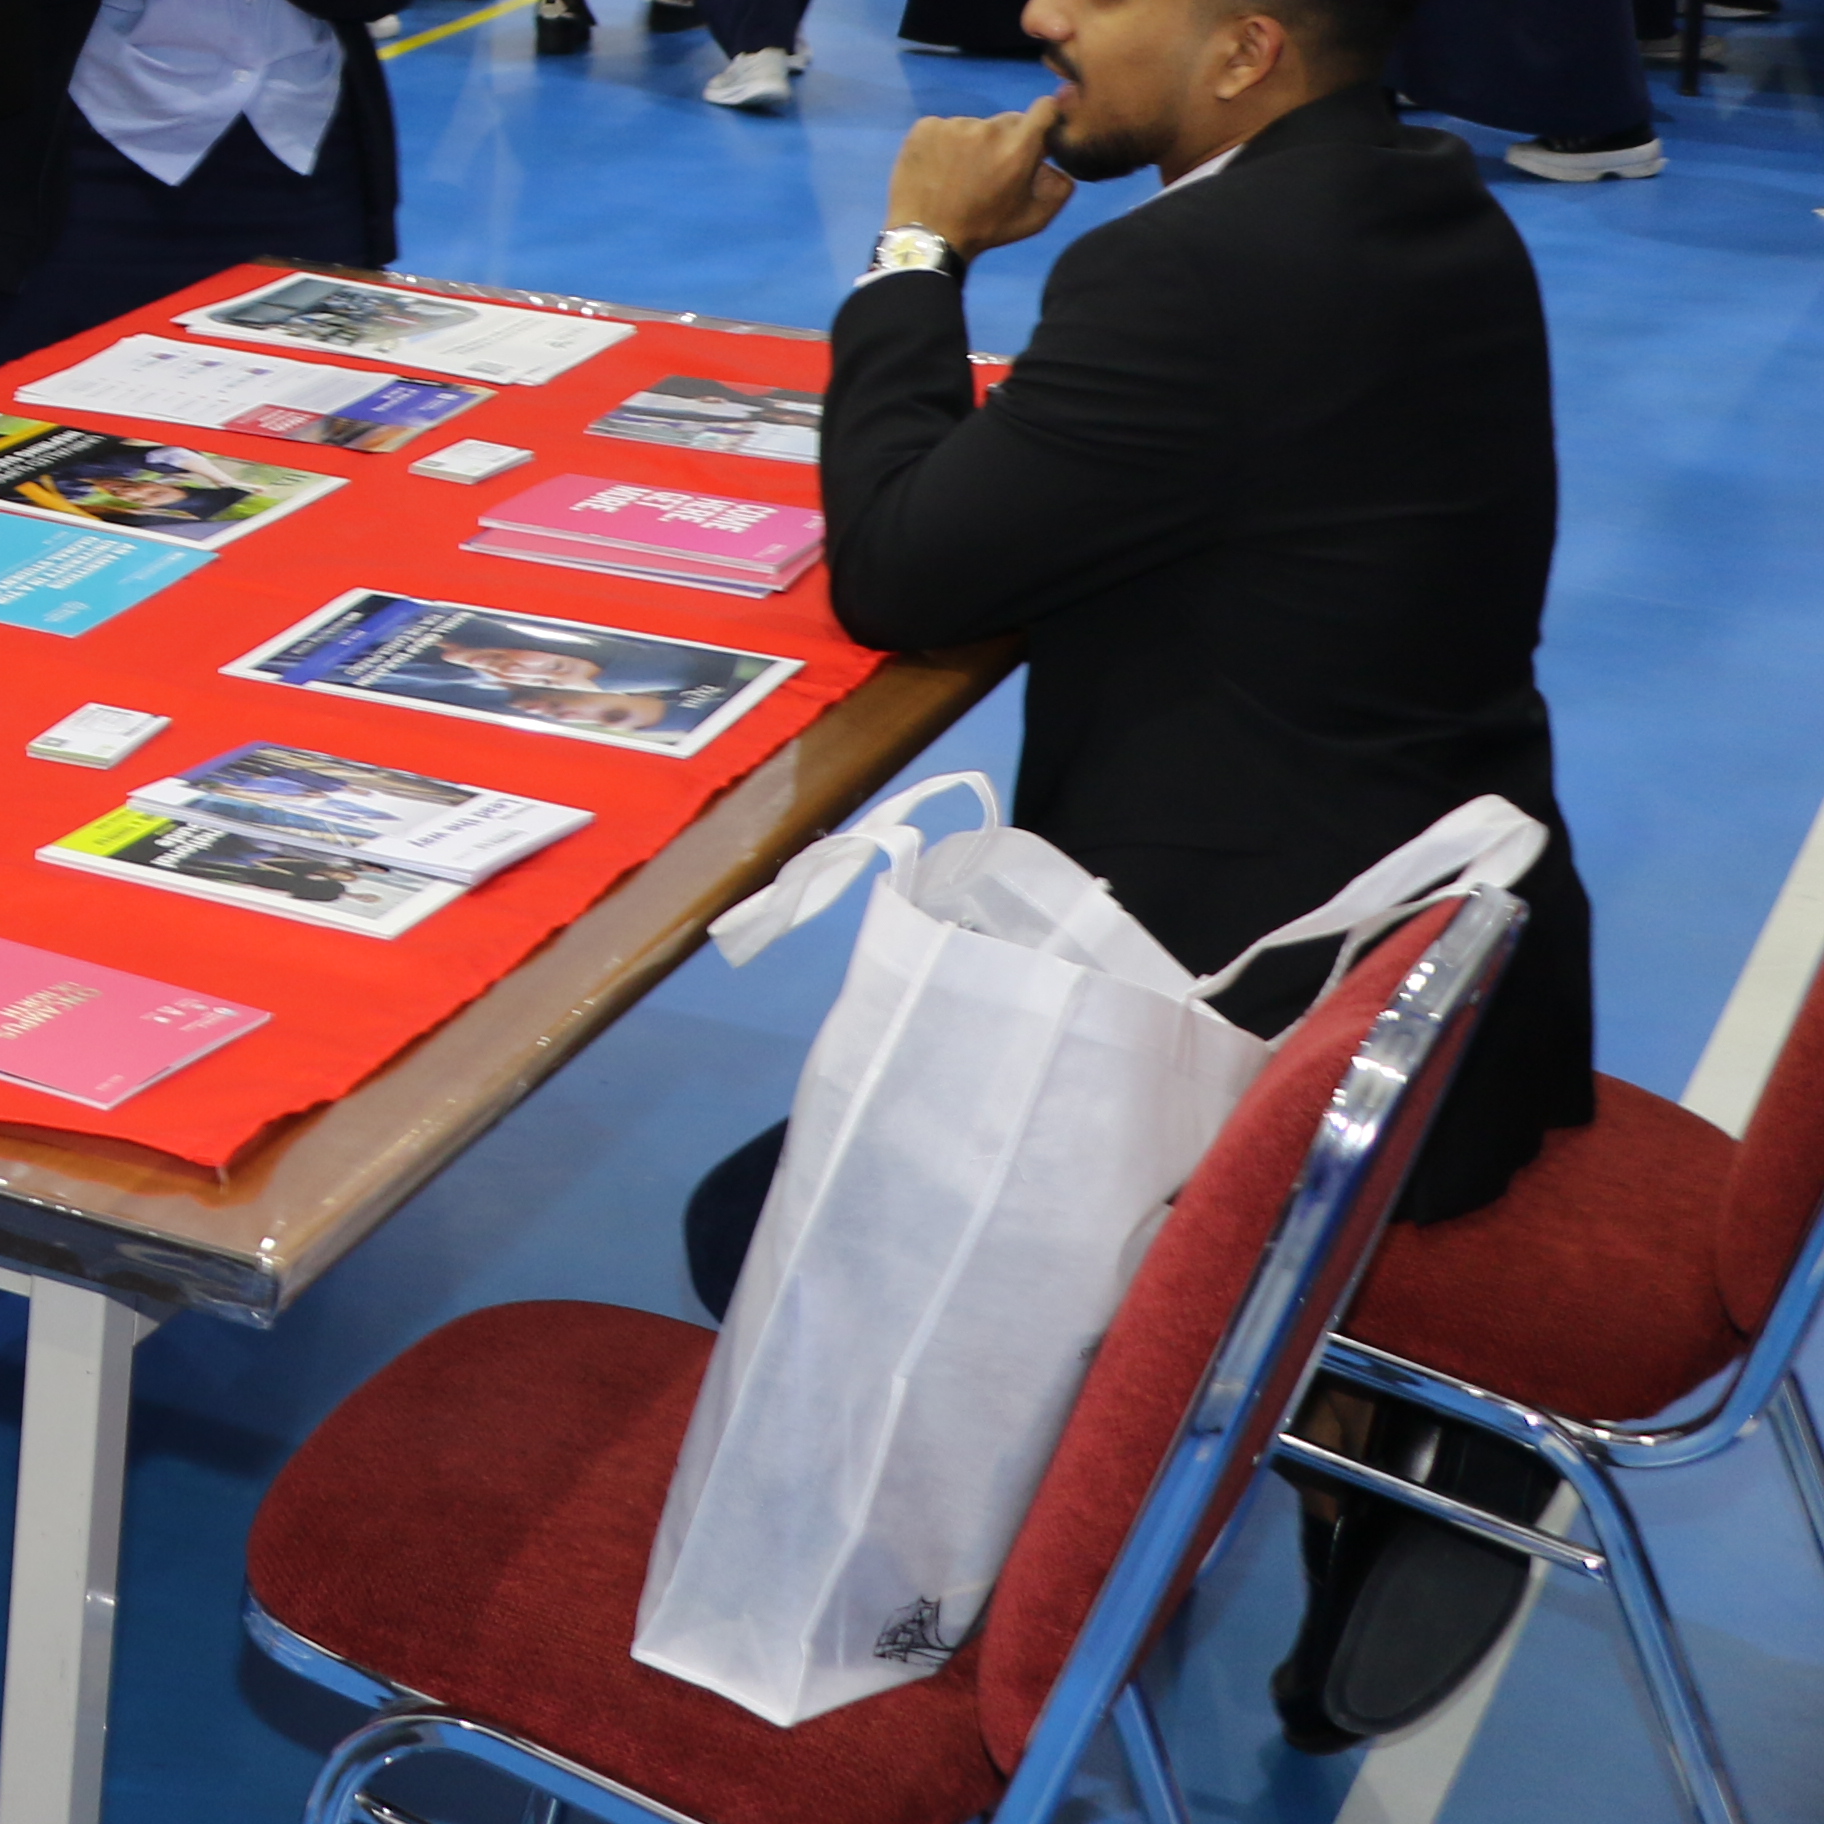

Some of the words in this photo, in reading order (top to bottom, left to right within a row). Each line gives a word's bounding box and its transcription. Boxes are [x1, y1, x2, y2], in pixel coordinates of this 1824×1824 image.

[569, 484, 652, 514] MORE.
[635, 491, 692, 511] GET
[657, 497, 738, 524] HERE.
[700, 504, 779, 534] COME
[45, 539, 118, 578] UNIVERSITY
[48, 535, 100, 561] GLOBAL
[111, 542, 137, 555] AN
[26, 576, 50, 586] IN
[48, 553, 118, 590] AMBITIOUS
[471, 797, 522, 819] Lead
[445, 817, 482, 832] the
[408, 831, 449, 849] way
